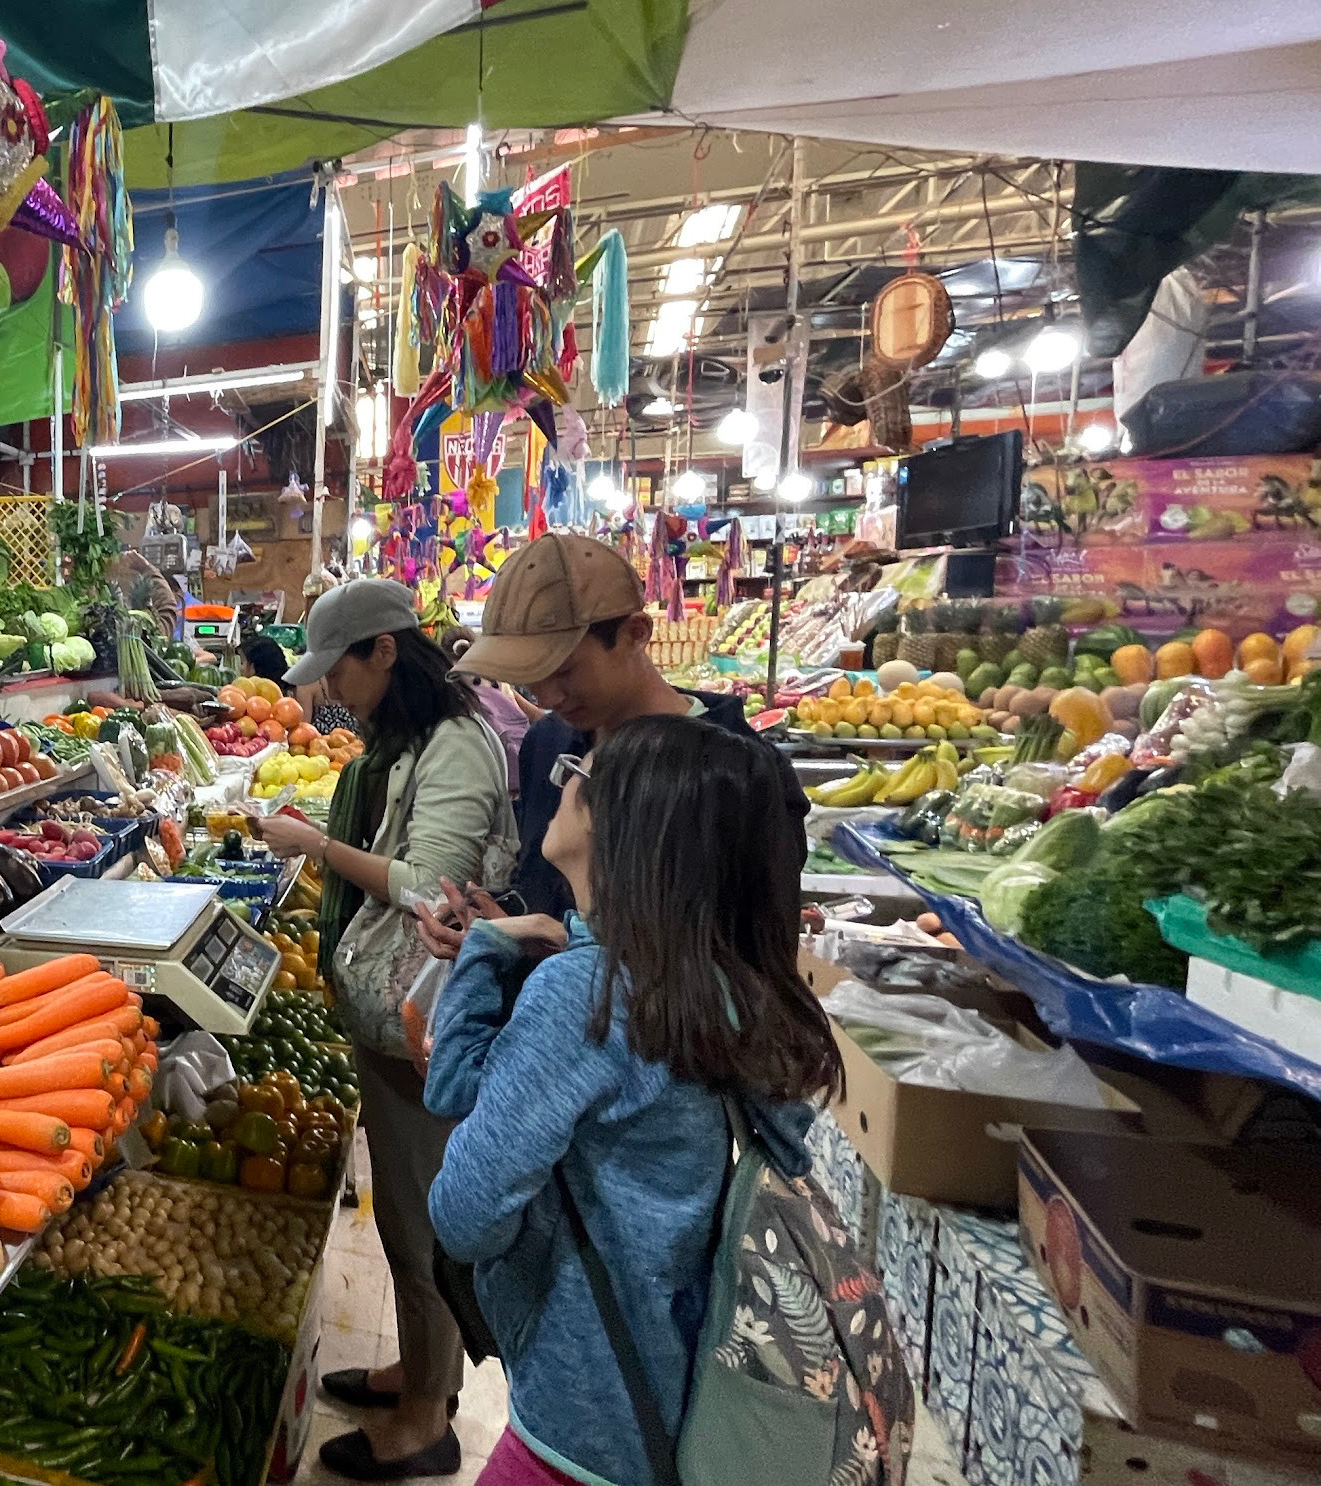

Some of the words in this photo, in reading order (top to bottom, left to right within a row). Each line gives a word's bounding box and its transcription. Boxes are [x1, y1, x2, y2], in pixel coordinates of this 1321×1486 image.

[447, 437, 502, 456] NECA
[1172, 469, 1191, 480] EL
[1194, 467, 1248, 479] SABOR
[1173, 484, 1248, 495] AVENTURA
